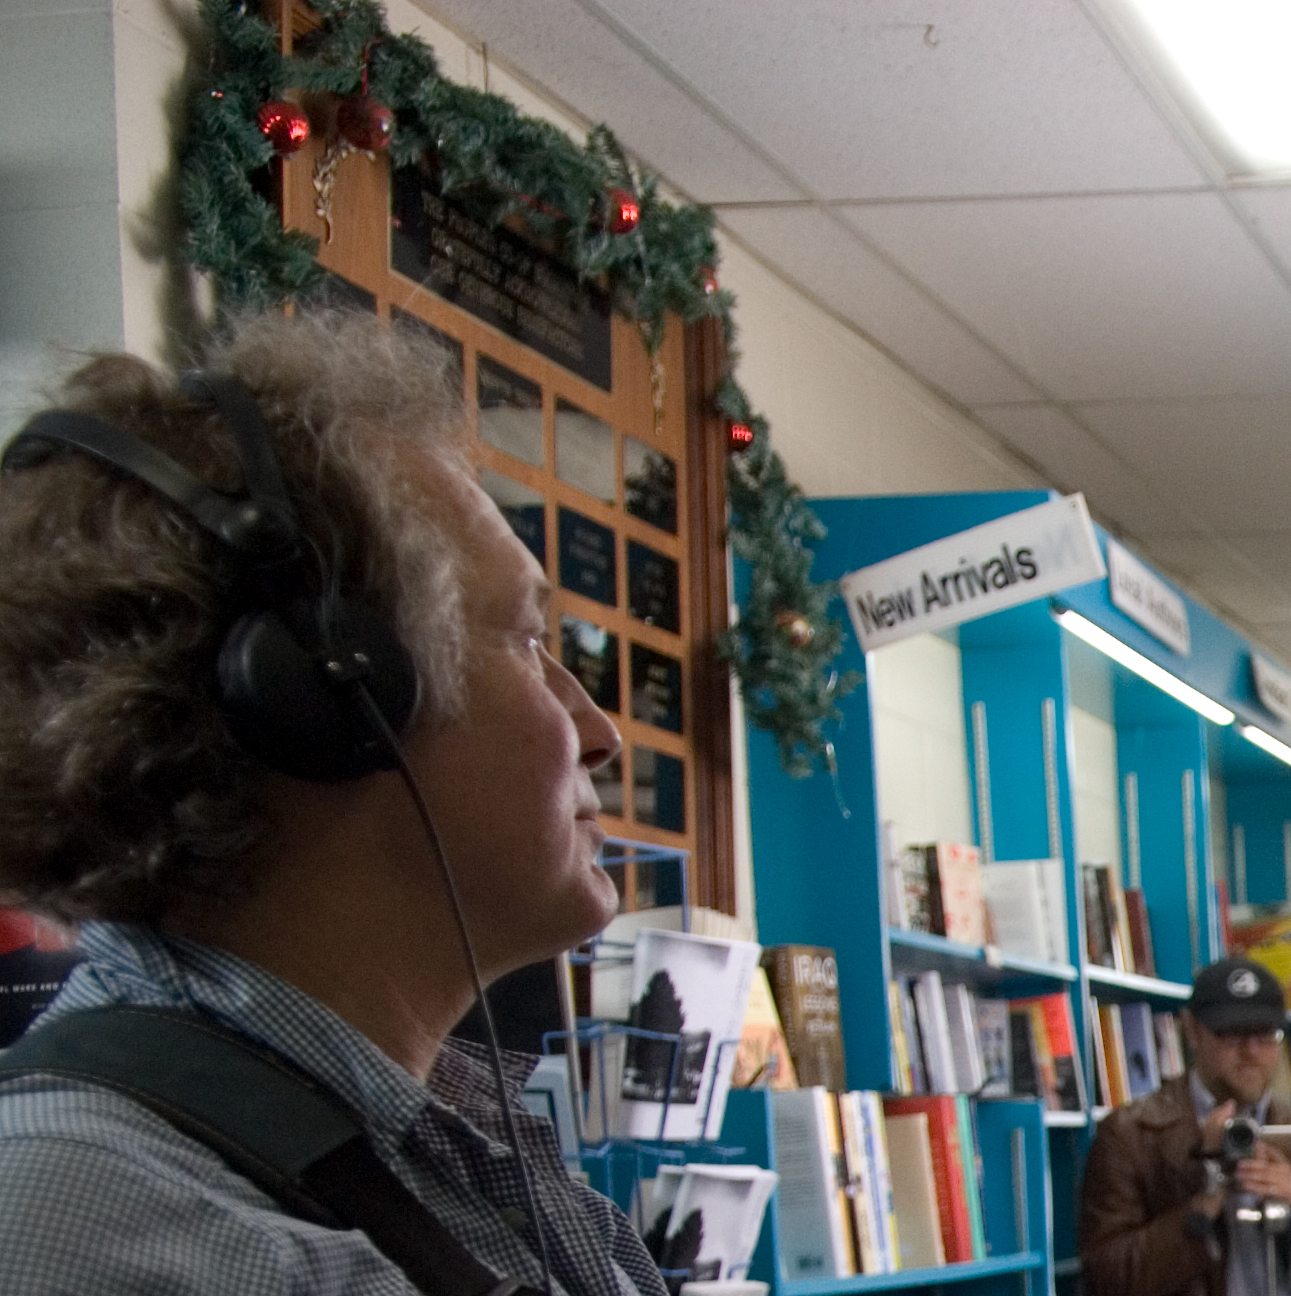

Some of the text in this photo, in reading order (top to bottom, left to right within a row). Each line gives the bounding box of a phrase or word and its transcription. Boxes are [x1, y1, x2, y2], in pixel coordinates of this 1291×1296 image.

[856, 541, 1040, 635] New Arrivals
[793, 954, 839, 989] IRAQ
